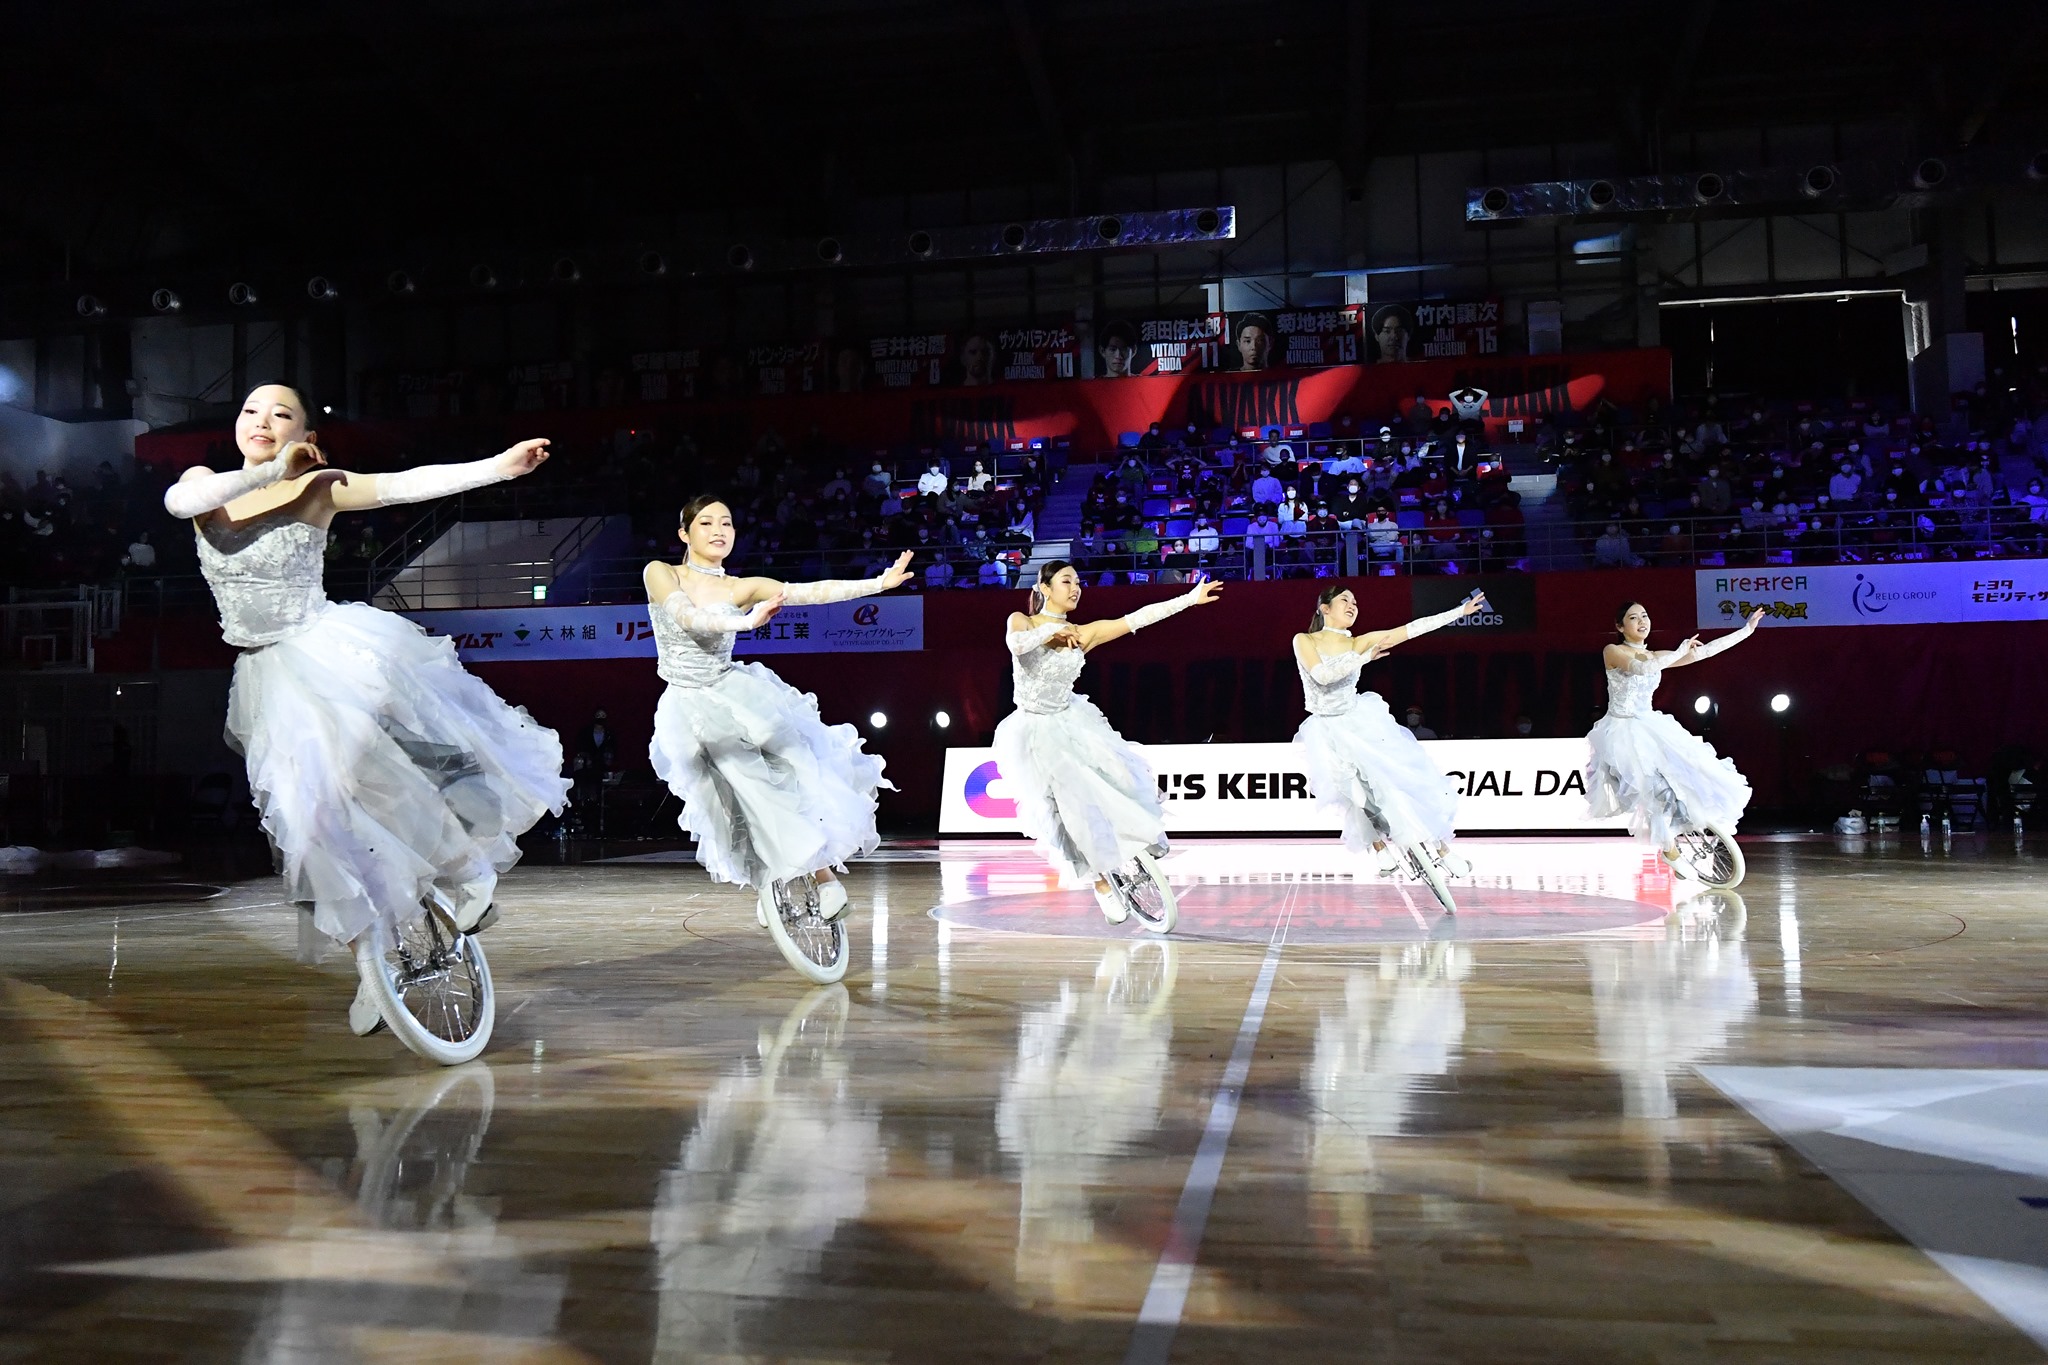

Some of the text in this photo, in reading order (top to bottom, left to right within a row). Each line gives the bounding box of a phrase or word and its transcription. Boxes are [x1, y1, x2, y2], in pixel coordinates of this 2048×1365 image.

[1276, 310, 1357, 333] 菊地祥平
[1141, 317, 1220, 342] 須田侑太郎
[1433, 328, 1455, 342] JOJI
[1288, 335, 1320, 349] SHOHEI
[1150, 343, 1187, 358] YUTARO
[1285, 350, 1324, 365] KIKUCHI
[1157, 358, 1182, 372] SUDA
[1973, 580, 2014, 591] トヨタ
[1876, 591, 1938, 601] RELO GROUP
[540, 625, 596, 640] 大林組
[823, 628, 916, 639] イーアクティブグループ
[1218, 774, 1316, 800] KEIR
